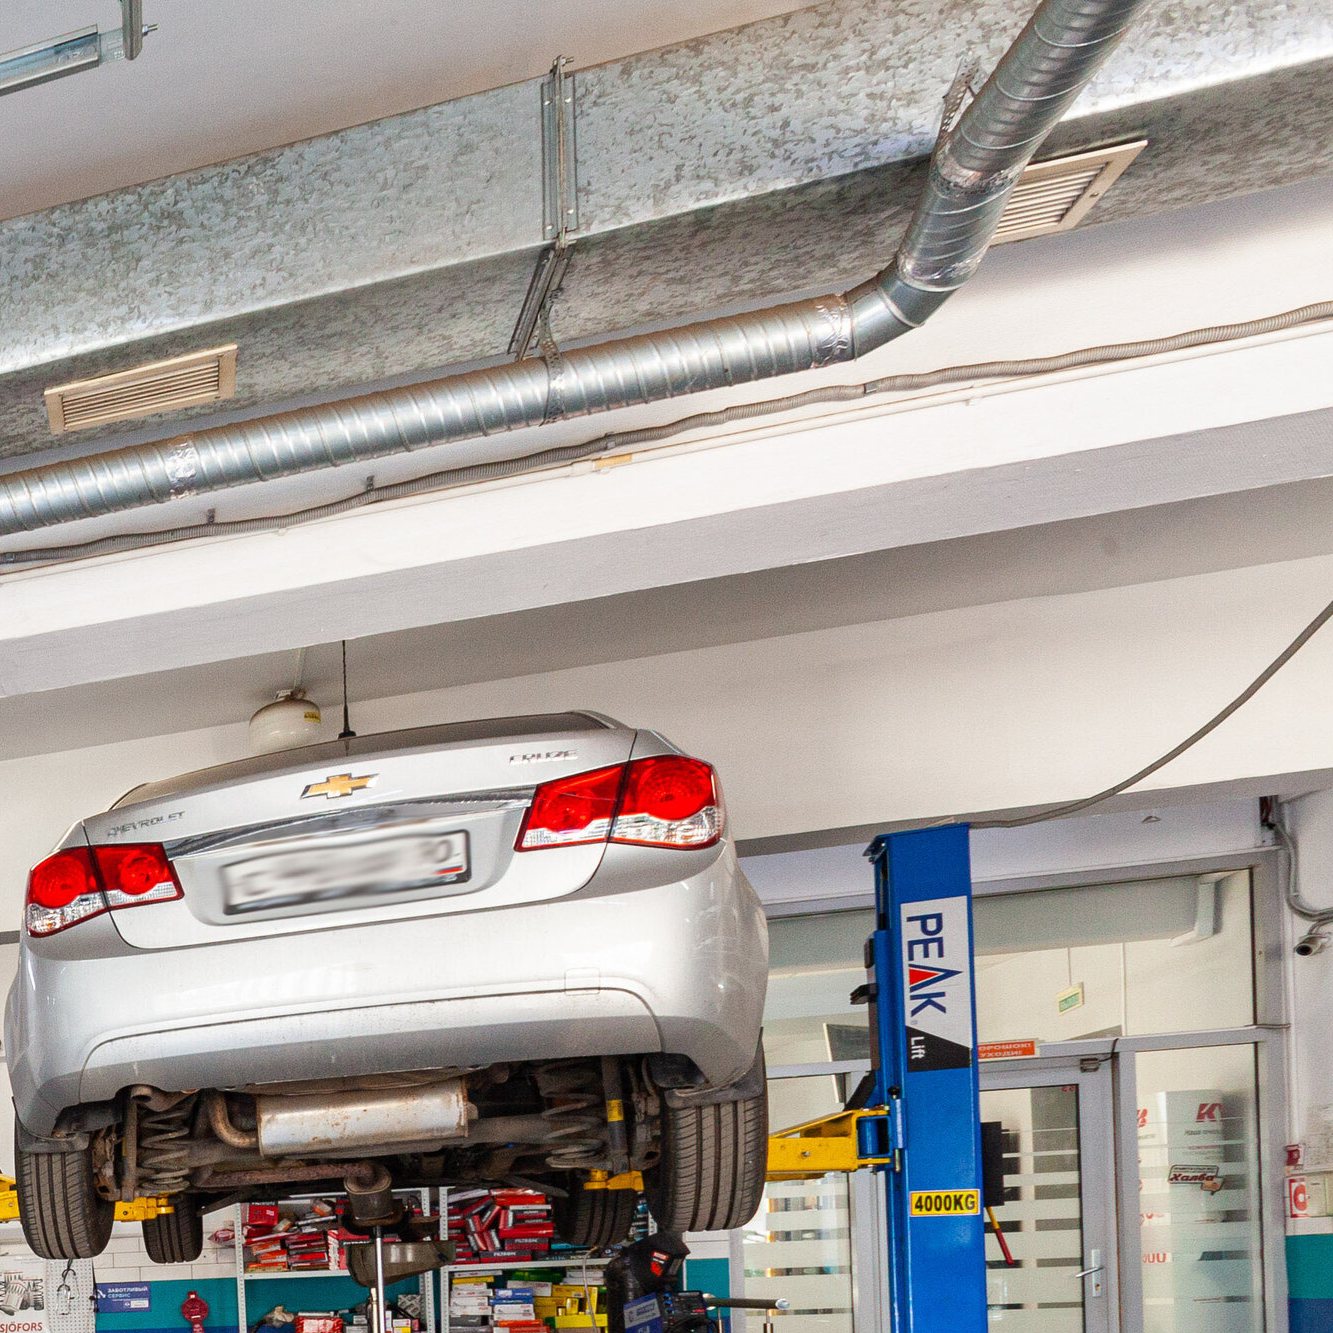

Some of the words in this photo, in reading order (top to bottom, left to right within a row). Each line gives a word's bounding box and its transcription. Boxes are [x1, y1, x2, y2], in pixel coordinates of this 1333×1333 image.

[108, 811, 185, 836] CHEVROLET
[906, 912, 964, 1018] PEAK
[910, 1036, 926, 1059] Lift
[914, 1194, 975, 1212] 4000KG
